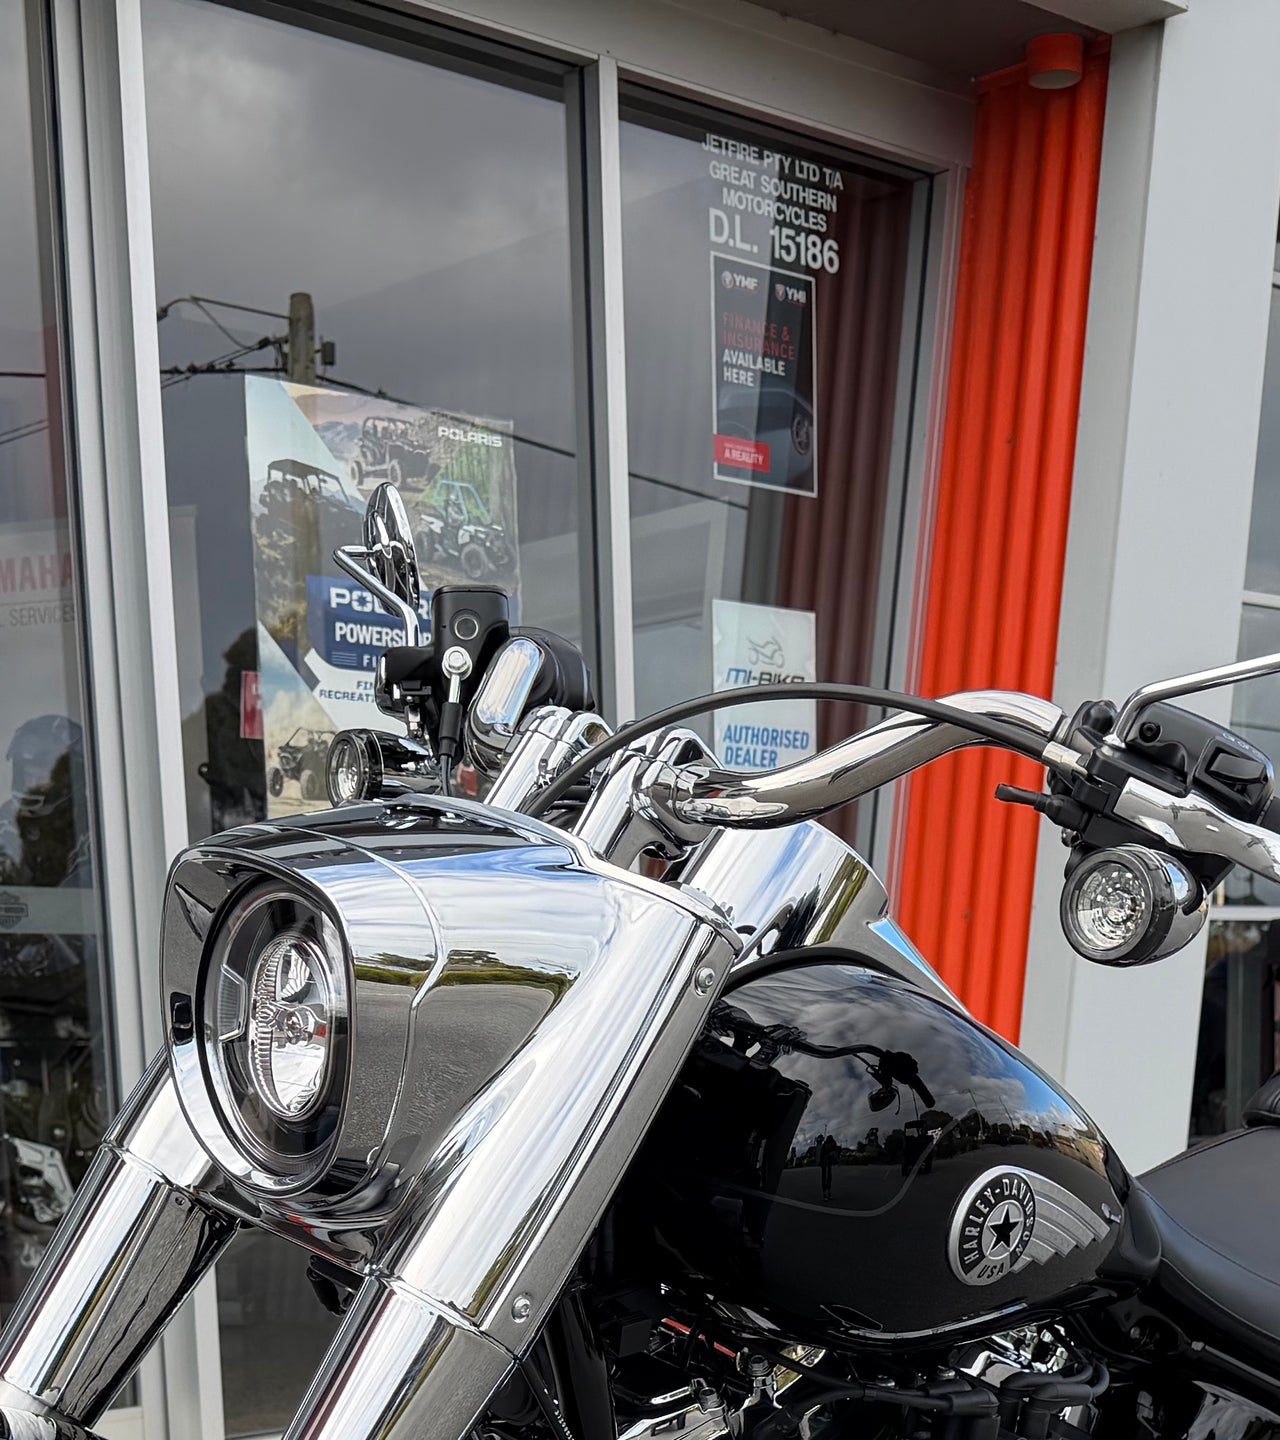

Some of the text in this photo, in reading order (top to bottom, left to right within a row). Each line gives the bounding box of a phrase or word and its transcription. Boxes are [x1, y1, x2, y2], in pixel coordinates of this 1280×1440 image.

[702, 133, 844, 190] JETFIRE PTY LTD T/A
[709, 161, 837, 212] GREAT SOUTHERN
[723, 187, 827, 232] MOTORCYCLES
[709, 207, 839, 274] D.L. 15186
[723, 312, 790, 342] FINANCE &
[723, 331, 795, 360] INSURANCE
[723, 349, 785, 376] AVAILABLE
[723, 366, 754, 386] HERE
[438, 426, 502, 447] POLARIS
[723, 724, 810, 750] AUTHORISED
[725, 746, 778, 768] DEALER
[963, 1178, 1034, 1264] HARLEY-DAVIDSON
[977, 1262, 1004, 1279] USA
